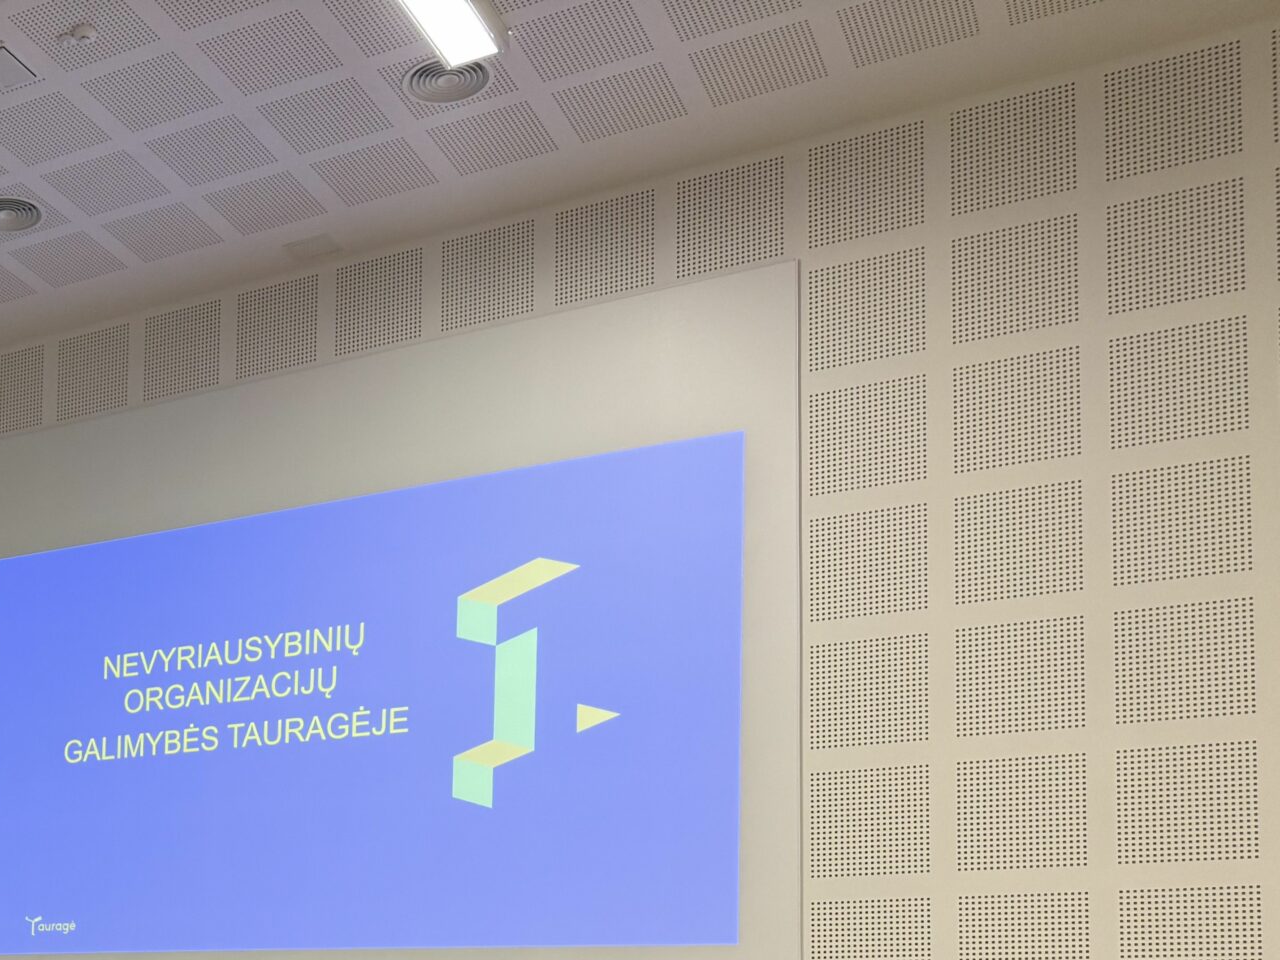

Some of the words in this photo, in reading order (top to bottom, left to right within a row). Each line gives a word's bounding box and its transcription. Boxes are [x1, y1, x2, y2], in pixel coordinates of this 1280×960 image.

[103, 622, 366, 680] NEVYRIAUSYBINIŲ
[123, 665, 339, 715] ORGANIZACIJŲ
[63, 720, 219, 764] GALIMYBĖS
[227, 705, 410, 750] TAURAGĖJE
